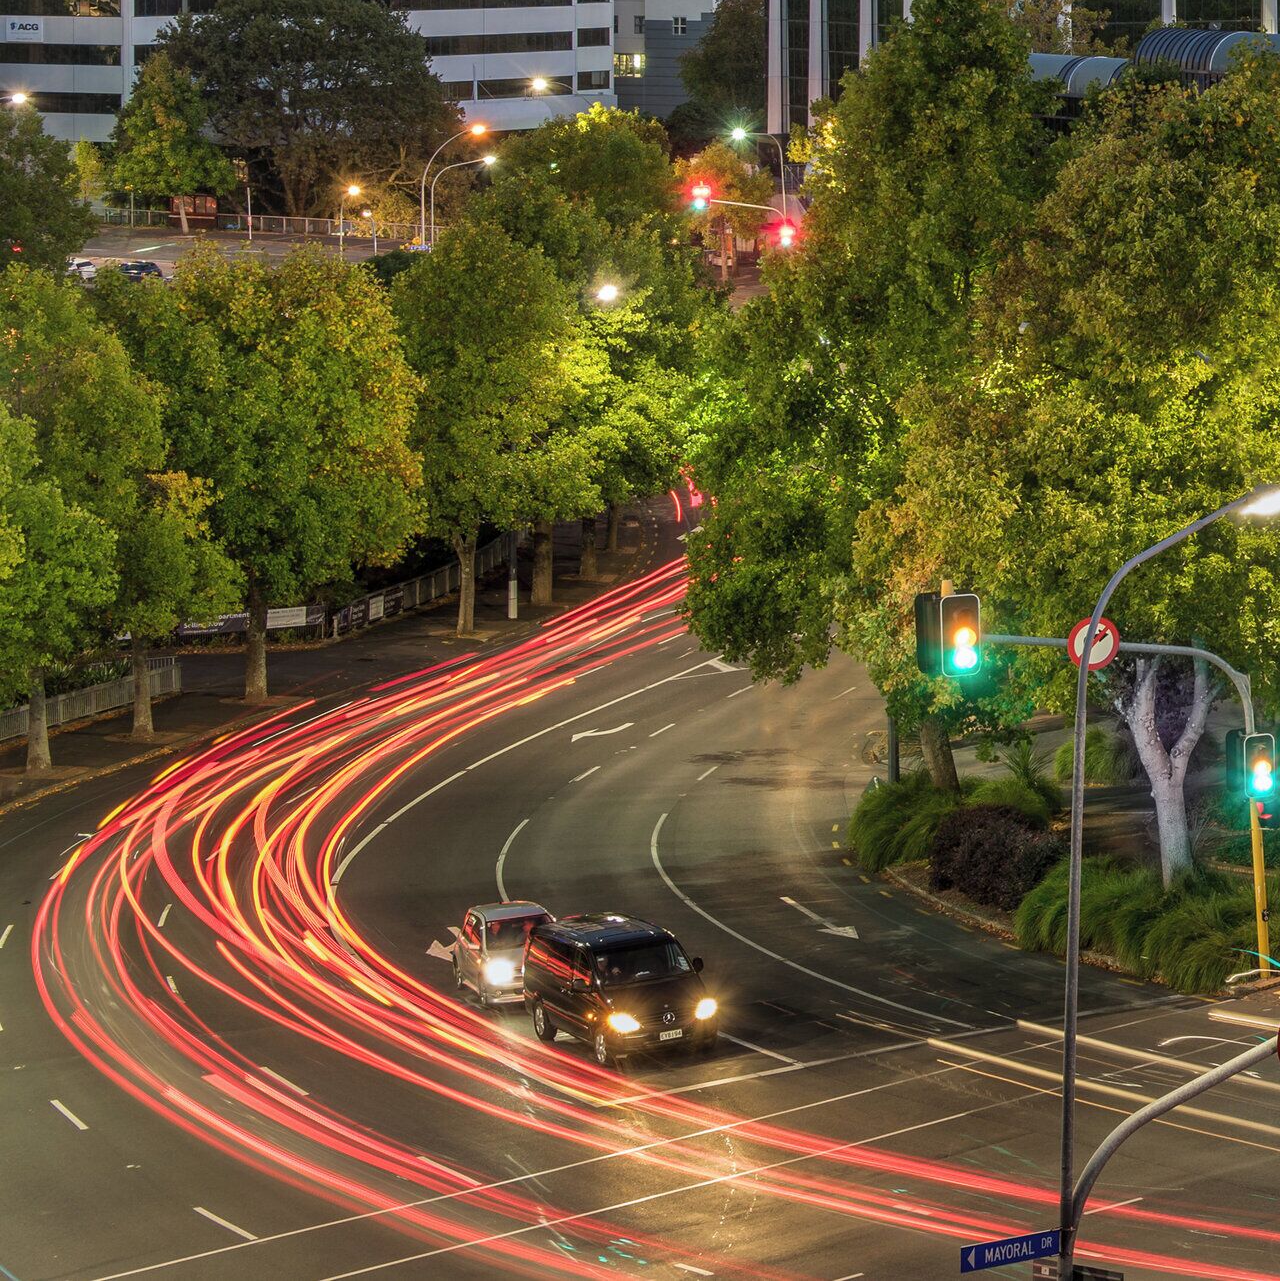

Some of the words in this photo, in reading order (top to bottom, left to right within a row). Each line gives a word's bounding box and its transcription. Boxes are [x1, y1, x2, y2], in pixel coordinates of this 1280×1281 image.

[18, 23, 39, 31] ACG
[985, 1241, 1035, 1263] MAYORAL
[1041, 1236, 1053, 1249] DR
